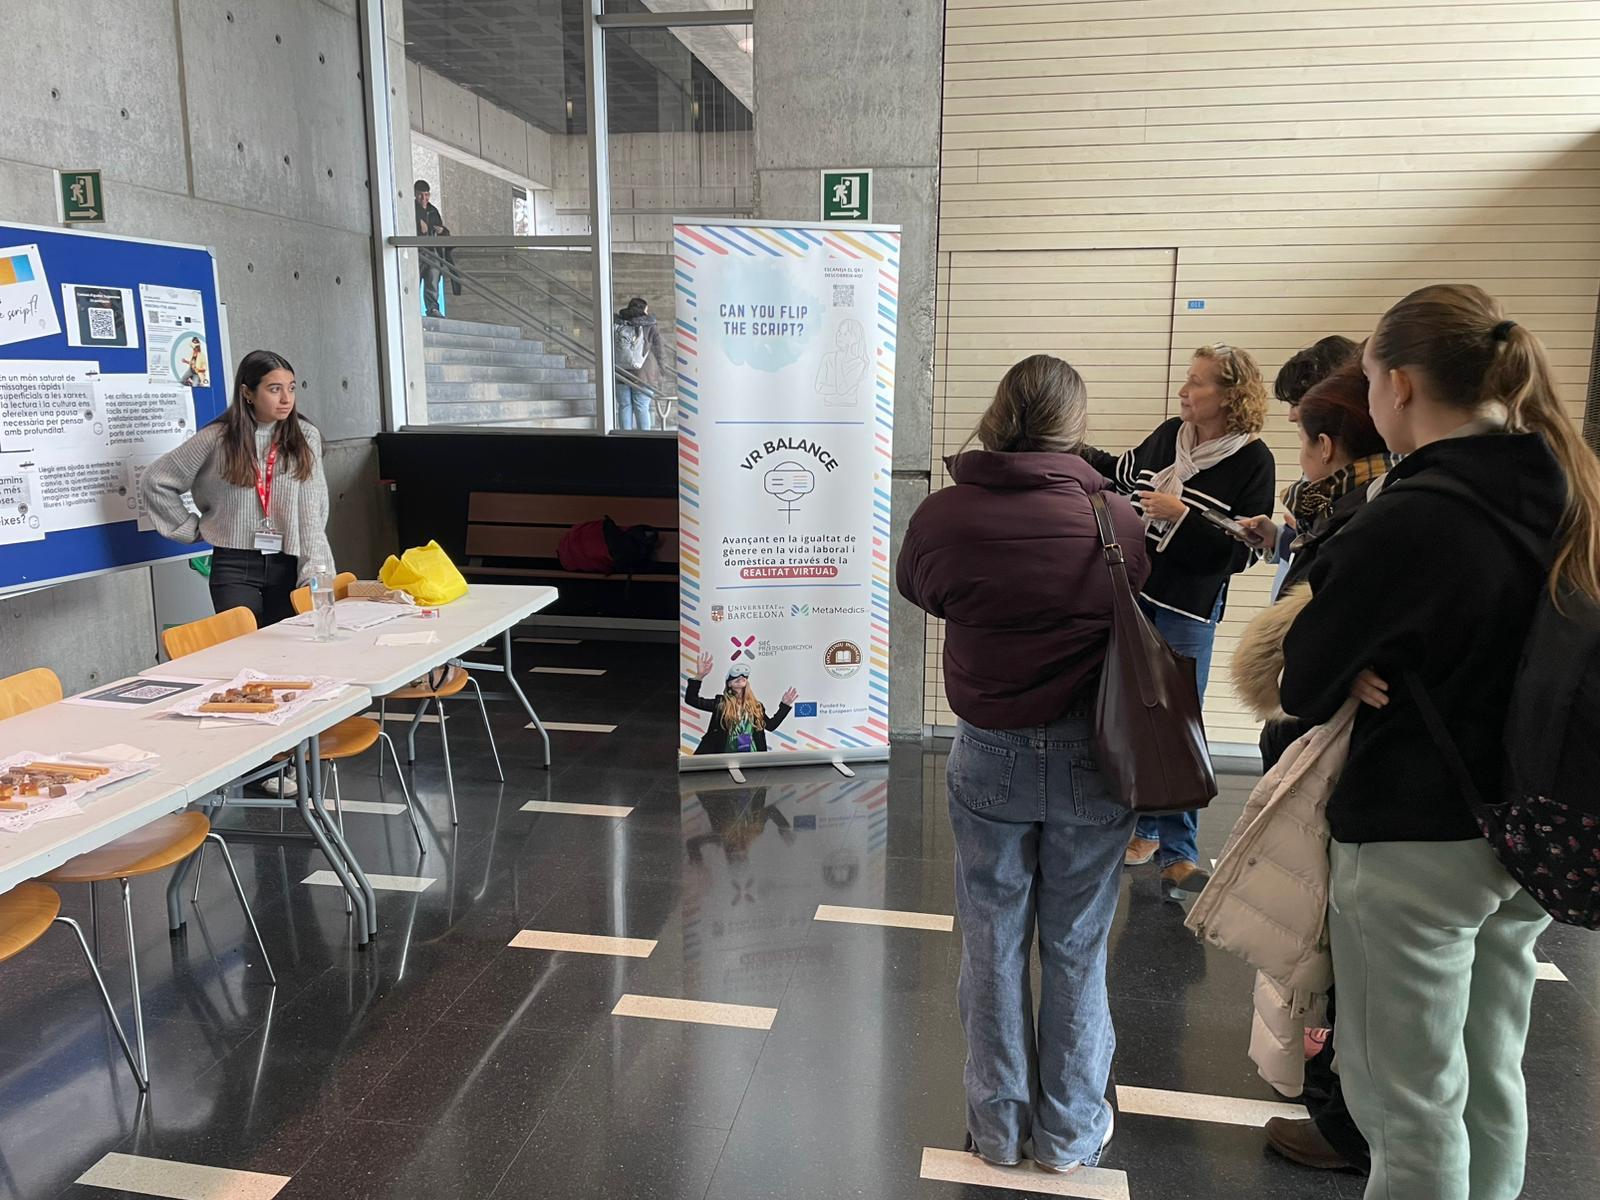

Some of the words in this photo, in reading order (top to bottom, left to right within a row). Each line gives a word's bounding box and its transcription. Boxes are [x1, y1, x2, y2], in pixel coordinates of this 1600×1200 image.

[720, 304, 745, 318] CAN
[750, 304, 775, 318] YOU
[780, 305, 808, 319] FLIP
[724, 322, 746, 336] THE
[752, 322, 804, 336] SCRIPT?
[38, 382, 61, 391] ràpids
[0, 392, 42, 401] superficials
[60, 418, 84, 426] pensar
[740, 450, 764, 473] VR
[763, 437, 839, 473] BALANCE
[4, 485, 21, 494] més
[0, 514, 26, 526] ixes?
[722, 536, 769, 545] Avançant
[801, 535, 841, 544] igualtat
[723, 546, 757, 557] gènere
[813, 545, 849, 554] laboral
[724, 557, 776, 566] domèstica
[789, 557, 820, 565] través
[823, 556, 836, 565] de
[839, 556, 848, 564] la
[743, 568, 790, 577] REALITAT
[792, 567, 835, 576] VIRTUAL
[812, 606, 865, 614] MetaMedics
[728, 611, 784, 620] BARCELONA
